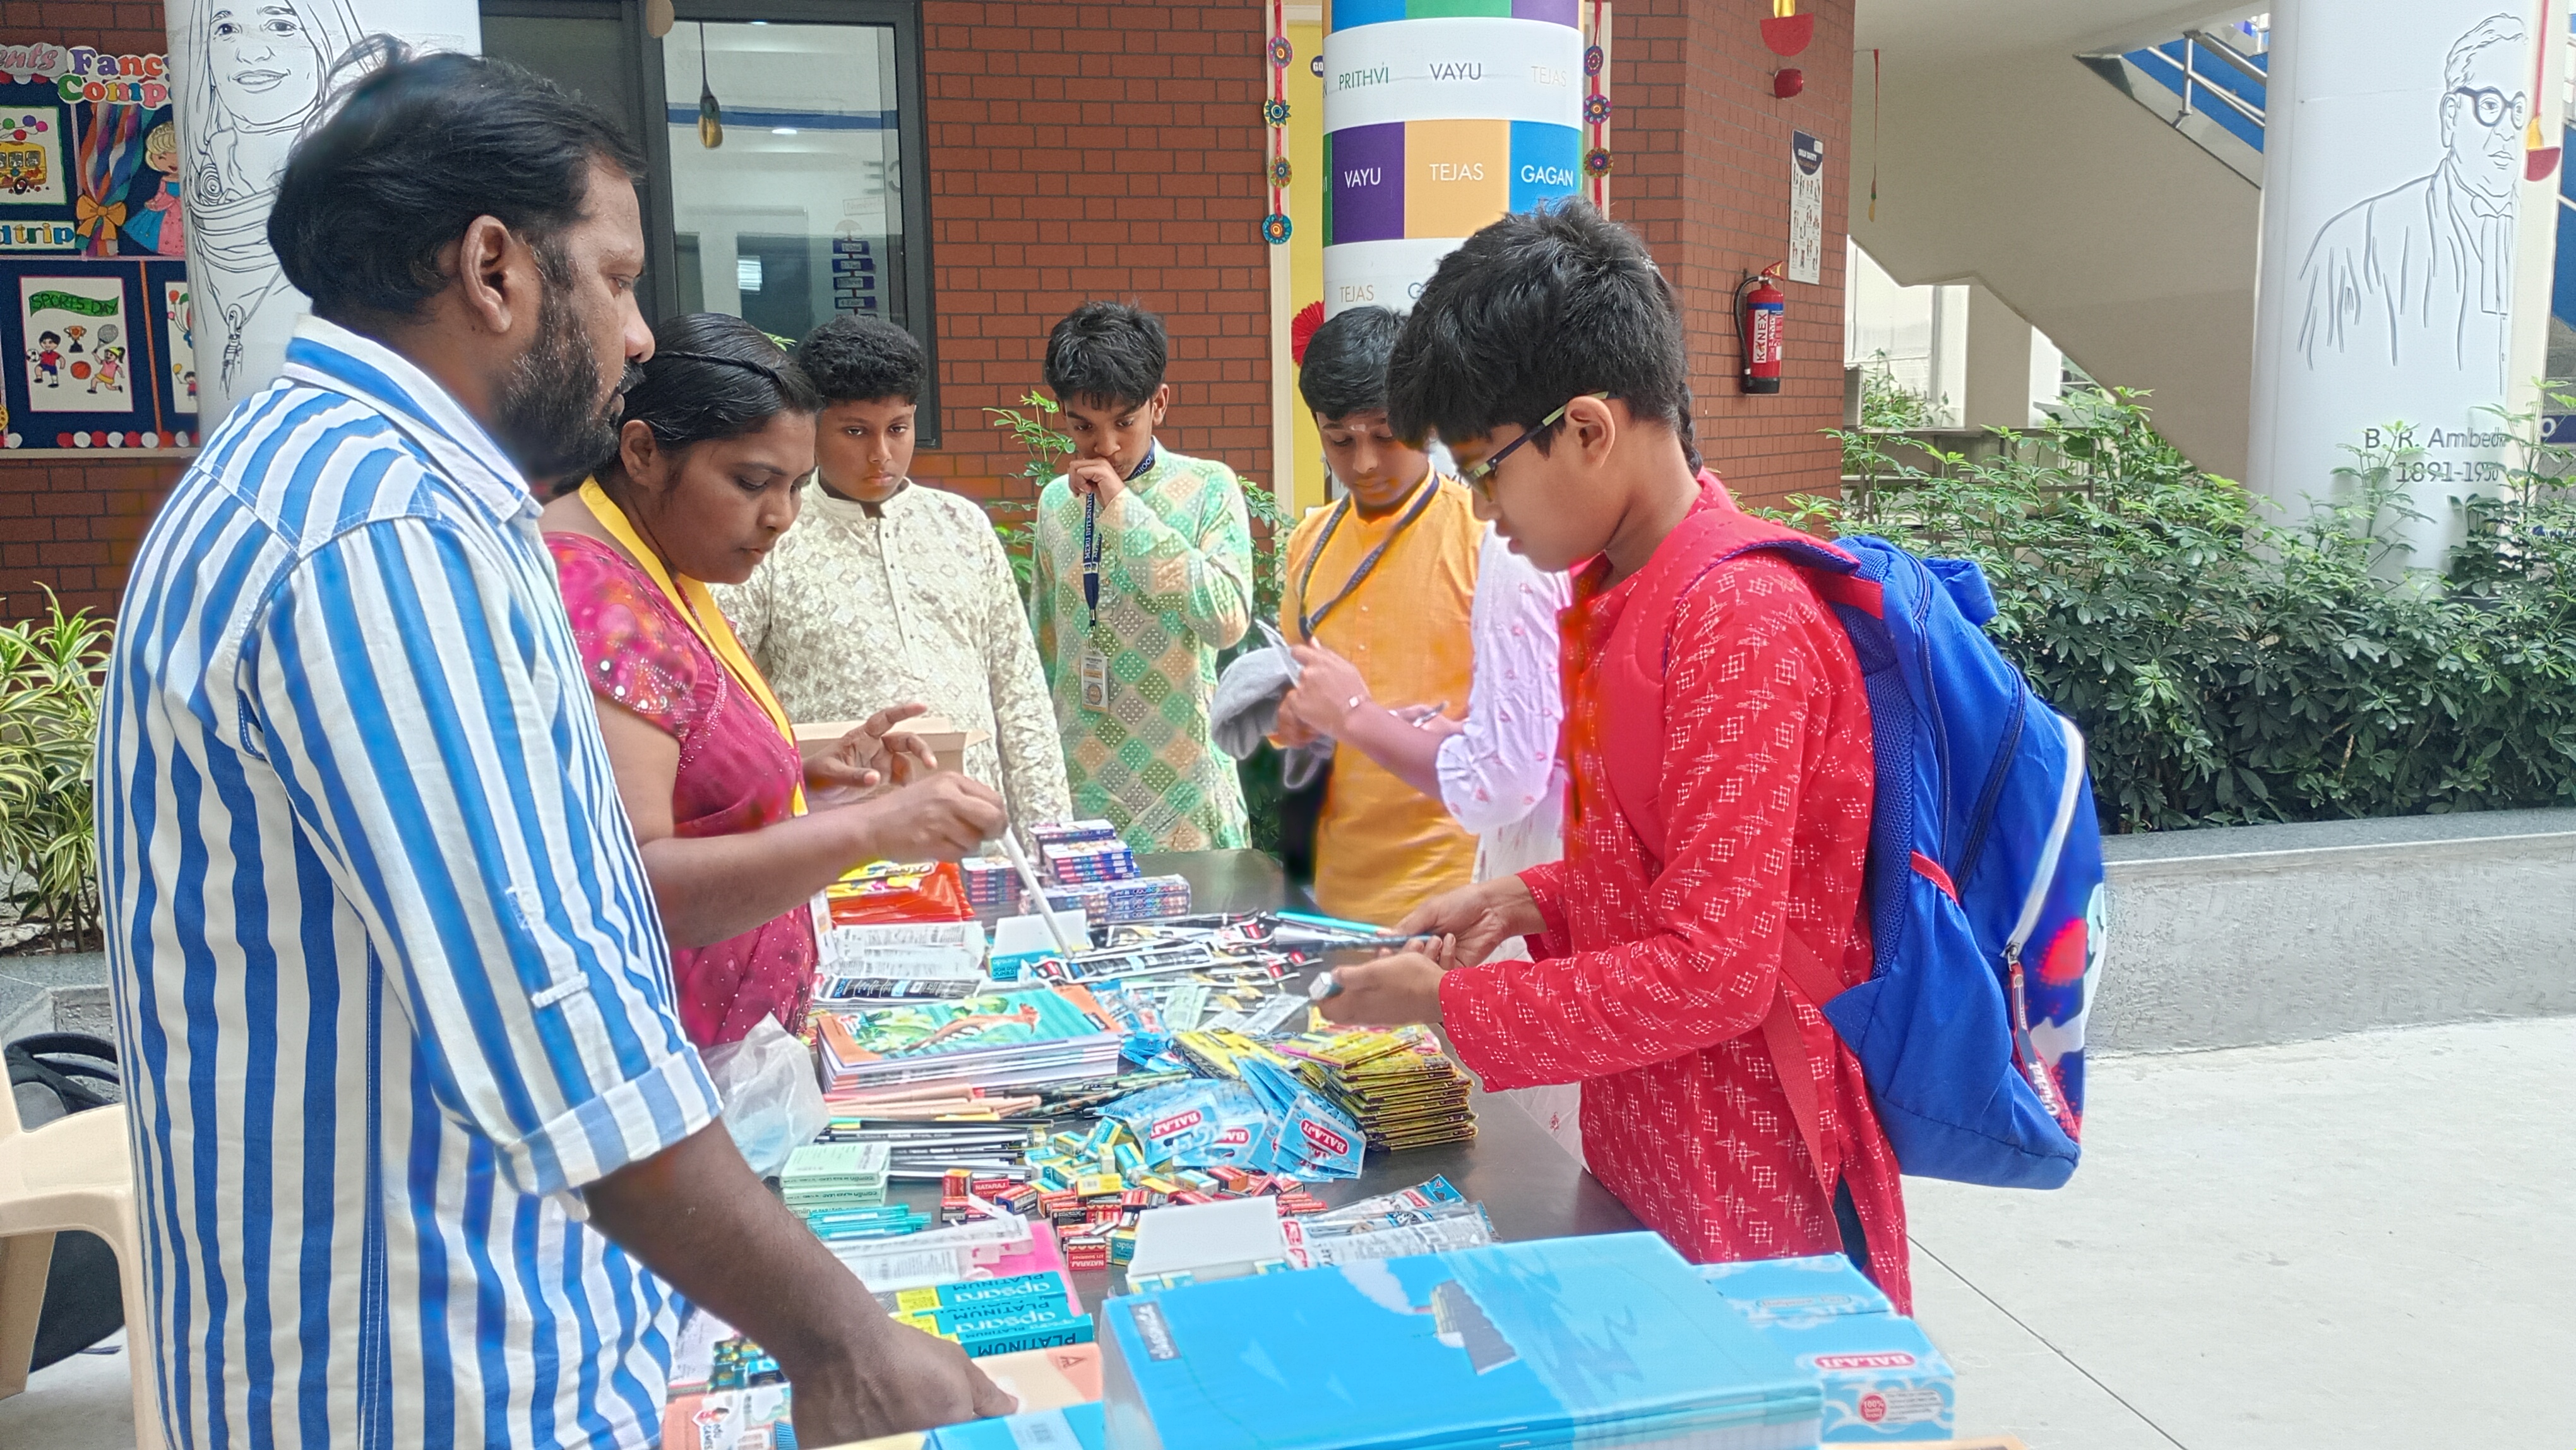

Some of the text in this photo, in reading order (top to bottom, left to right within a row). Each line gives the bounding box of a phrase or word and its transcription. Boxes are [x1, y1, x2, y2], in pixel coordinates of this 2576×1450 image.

[1339, 66, 1389, 91] PRITHVI
[1429, 62, 1482, 81] VAYU
[1531, 65, 1567, 87] TEJAS
[1344, 167, 1381, 188] VAYU
[1429, 163, 1484, 181] TEJAS
[1520, 164, 1574, 187] GAGAN
[1339, 284, 1374, 303] TEJAS
[32, 293, 118, 316] SPORTS DAY
[1083, 536, 1092, 560] MERU
[1302, 1120, 1346, 1154] BALAJI
[975, 1182, 1006, 1190] NATARAJ
[952, 1273, 1044, 1291] PLATINUM
[955, 1281, 1051, 1303] apsara
[953, 1302, 1050, 1321] PLATINUM
[955, 1310, 1056, 1333] apsara
[965, 1326, 1026, 1339] PLATINUM
[978, 1332, 1076, 1357] PLATINUM
[1820, 1355, 1907, 1369] BALAJI
[1863, 1399, 1885, 1408] 100%
